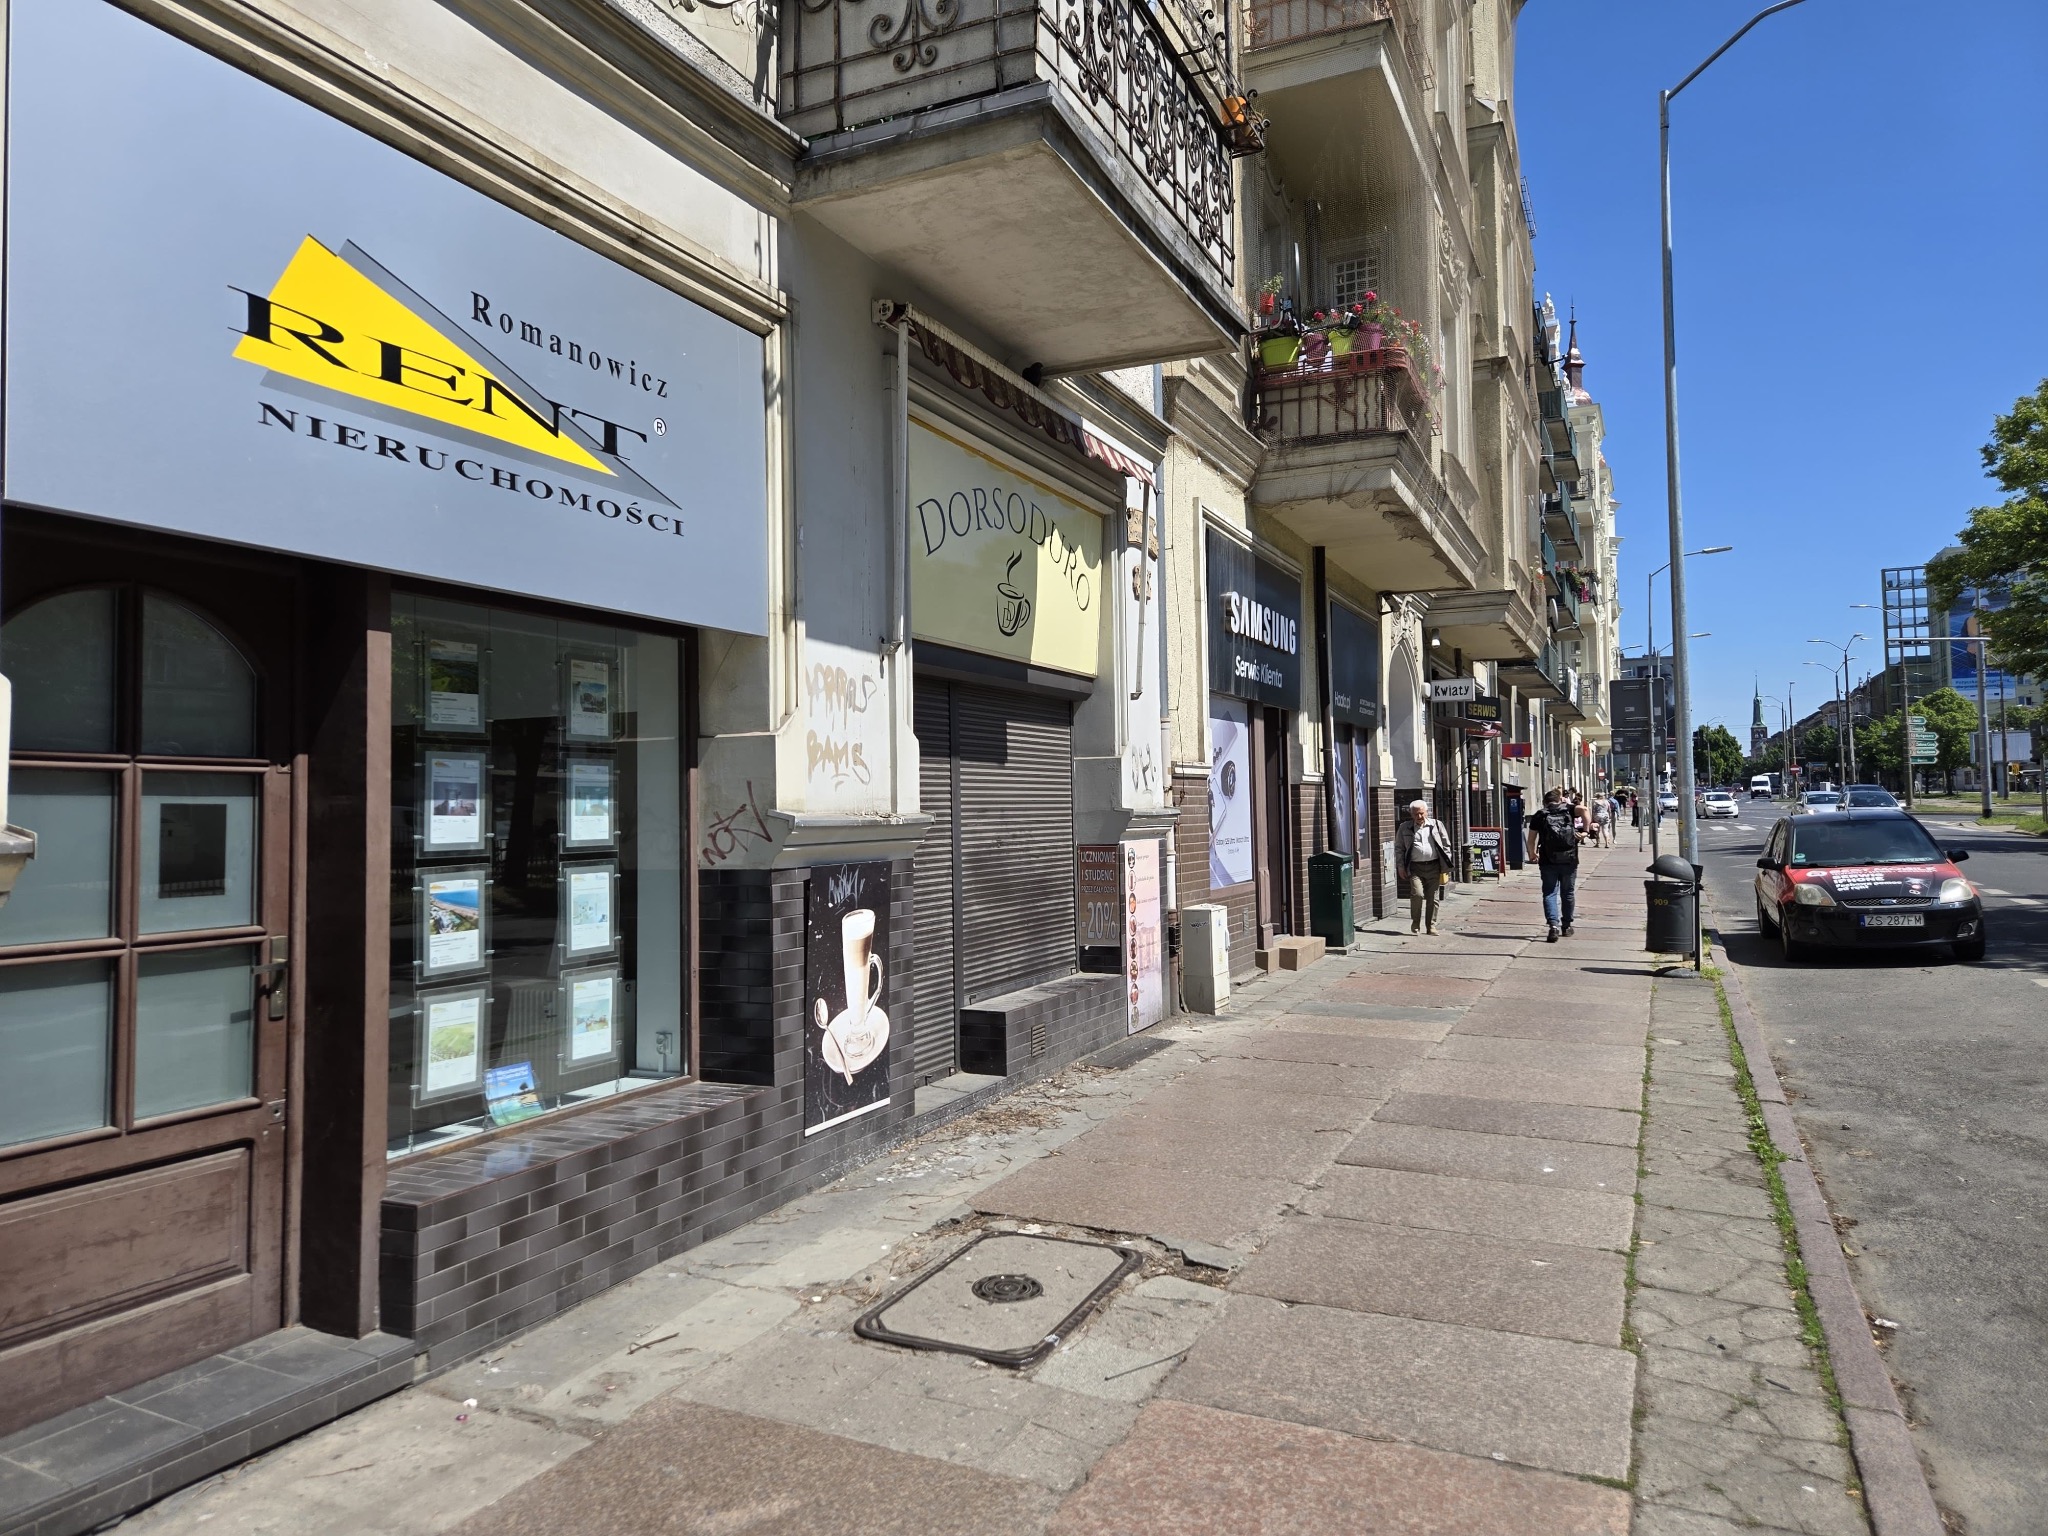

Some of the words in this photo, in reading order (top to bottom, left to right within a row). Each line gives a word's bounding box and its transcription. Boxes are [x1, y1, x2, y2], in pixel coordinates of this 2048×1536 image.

[471, 290, 669, 398] Romanowicz
[227, 285, 648, 461] RENT
[257, 401, 685, 538] NIERUCHOMOŚCI
[916, 487, 1091, 612] DORSODURO
[1230, 591, 1296, 655] SAMSUNG
[1235, 654, 1260, 682] Serwis
[1260, 663, 1283, 689] Klienta
[1434, 685, 1470, 697] Kwiaty
[1467, 703, 1497, 718] SERWIS
[1080, 850, 1116, 863] UCZNIOWIE
[1081, 869, 1084, 881] I
[1085, 869, 1115, 881] STUDENCI
[1081, 885, 1093, 893] PRZEZ
[1081, 901, 1117, 940] -20%
[1867, 915, 1882, 926] ZS
[1887, 915, 1922, 926] 287FM
